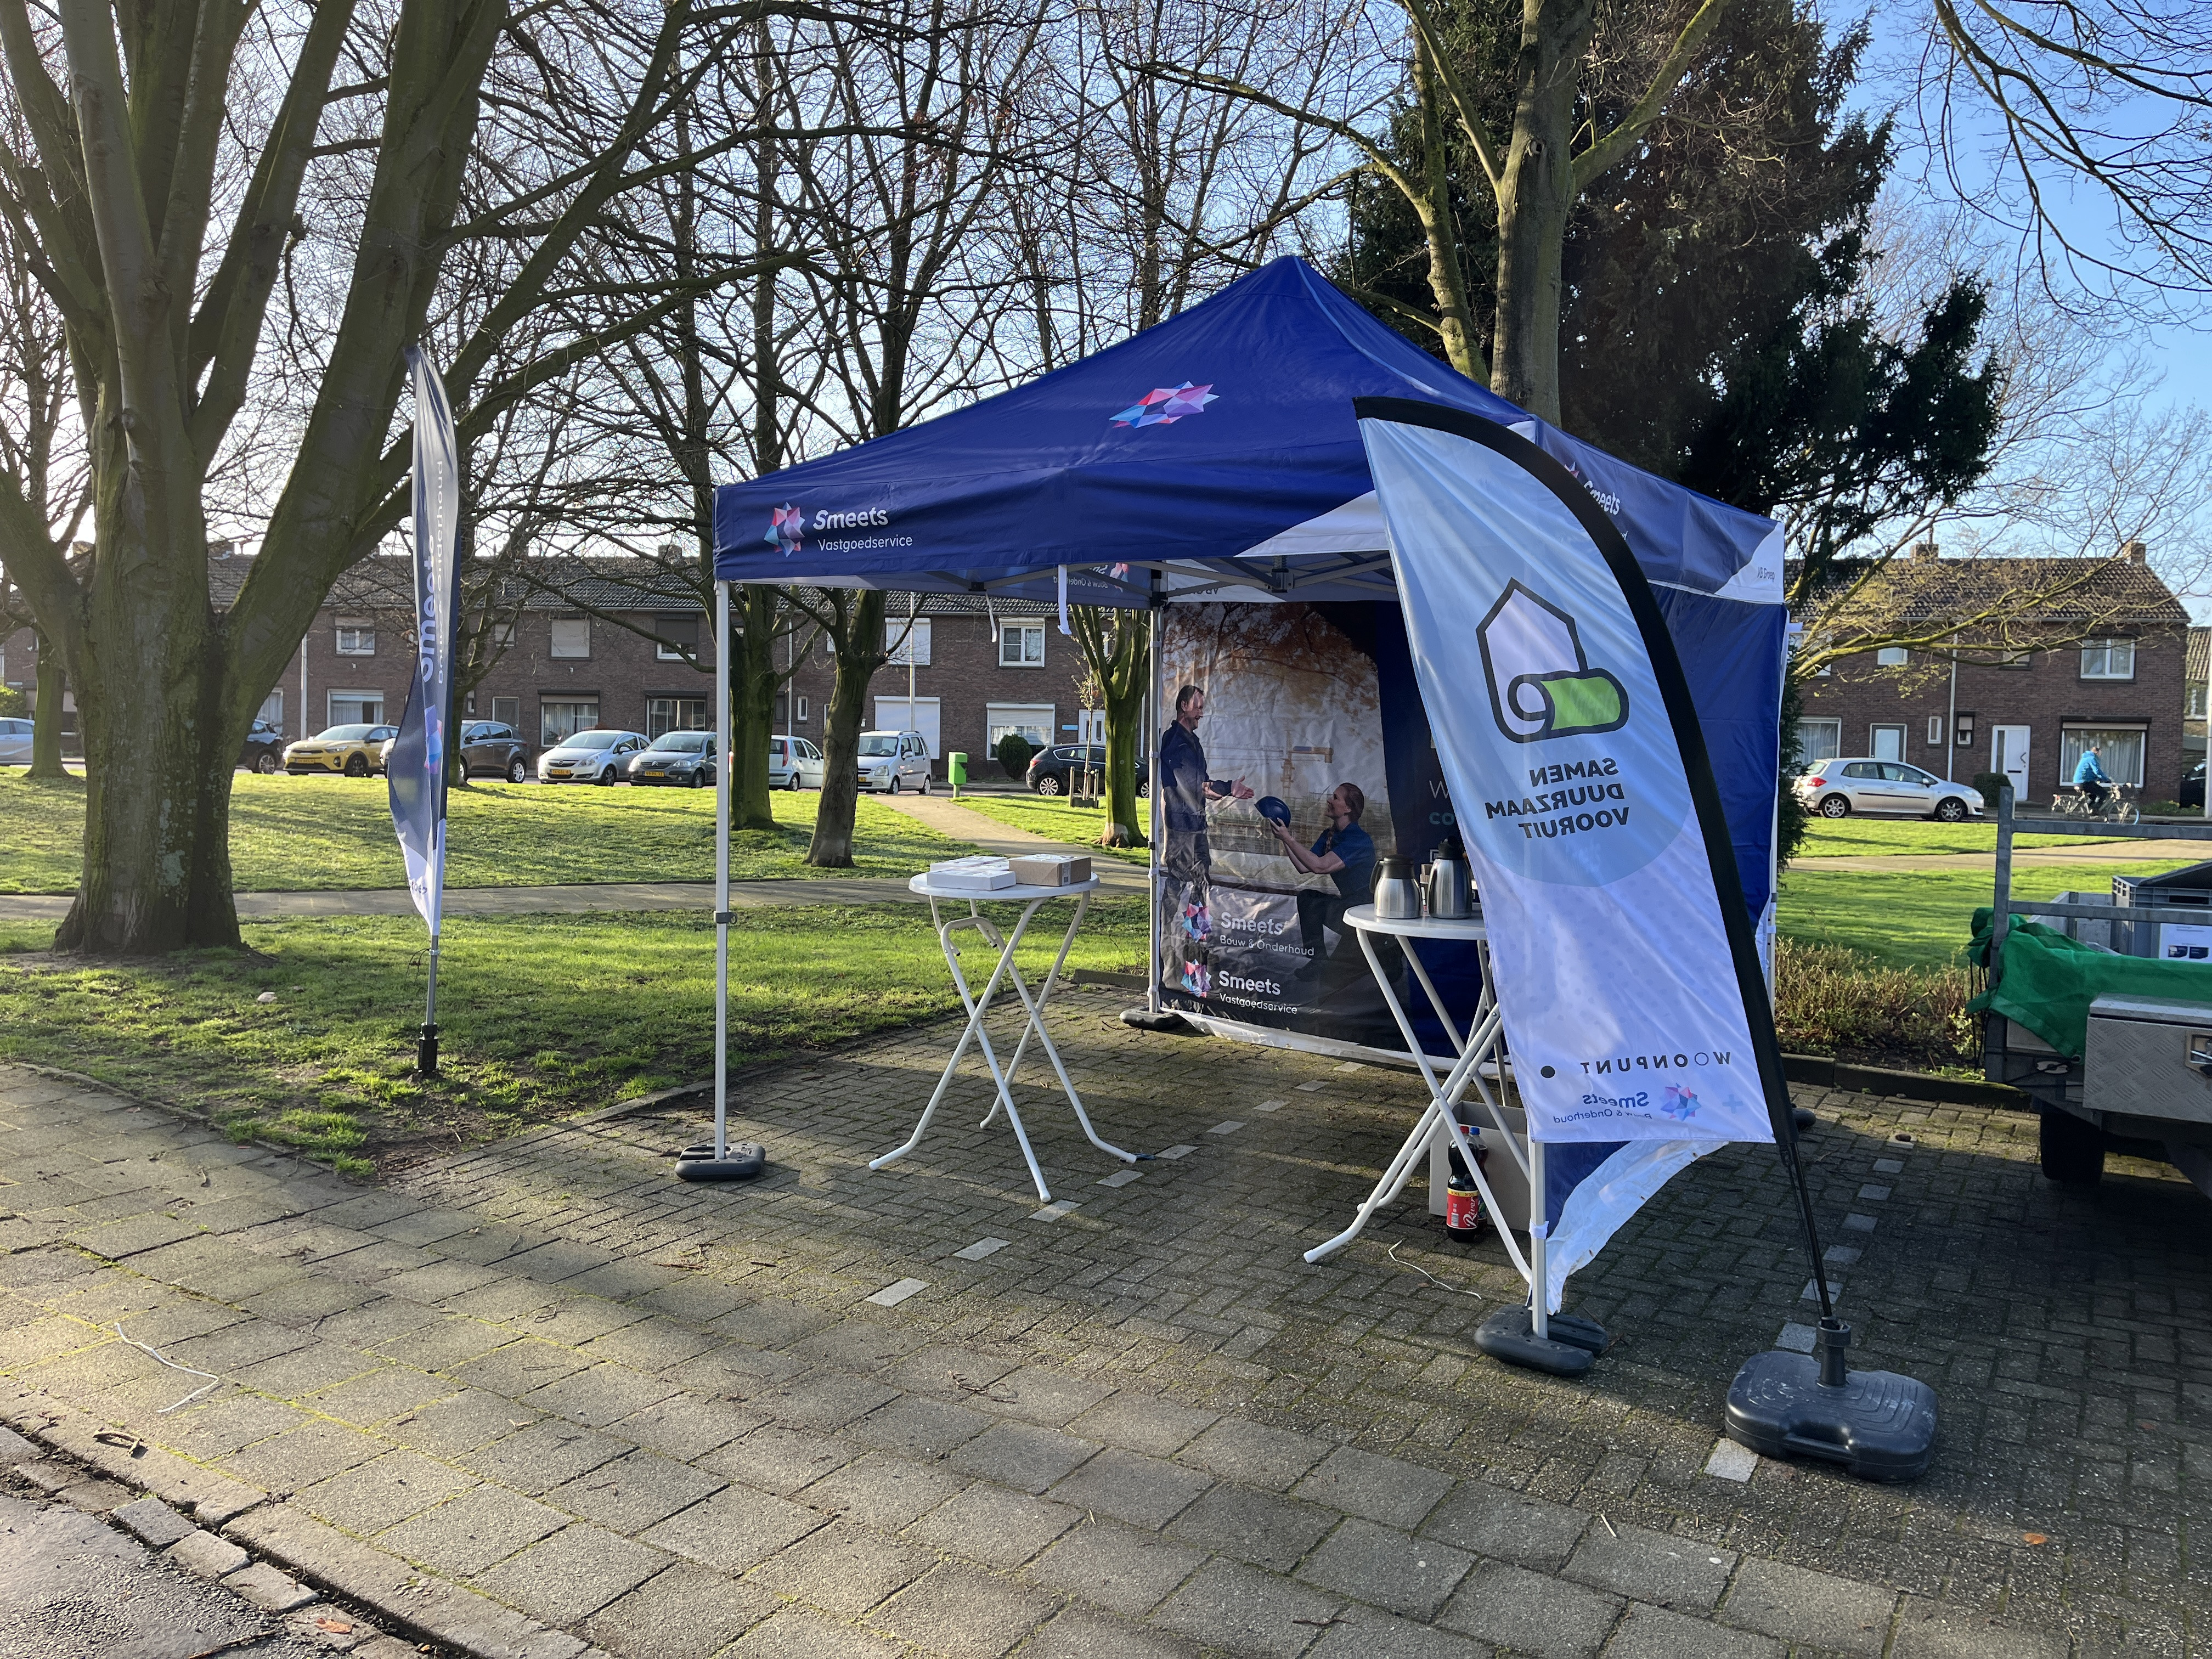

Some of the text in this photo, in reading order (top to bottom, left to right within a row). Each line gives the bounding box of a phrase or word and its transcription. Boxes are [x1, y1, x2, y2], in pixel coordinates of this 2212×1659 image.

[812, 507, 889, 531] Smeets
[817, 534, 913, 553] Vastgoedservice
[1221, 912, 1283, 935] Smeets
[1220, 934, 1315, 956] Bouw & Onderhoud
[1218, 970, 1281, 996] Smeets
[1219, 992, 1298, 1014] Vastgoedservice
[1463, 1197, 1477, 1227] River
